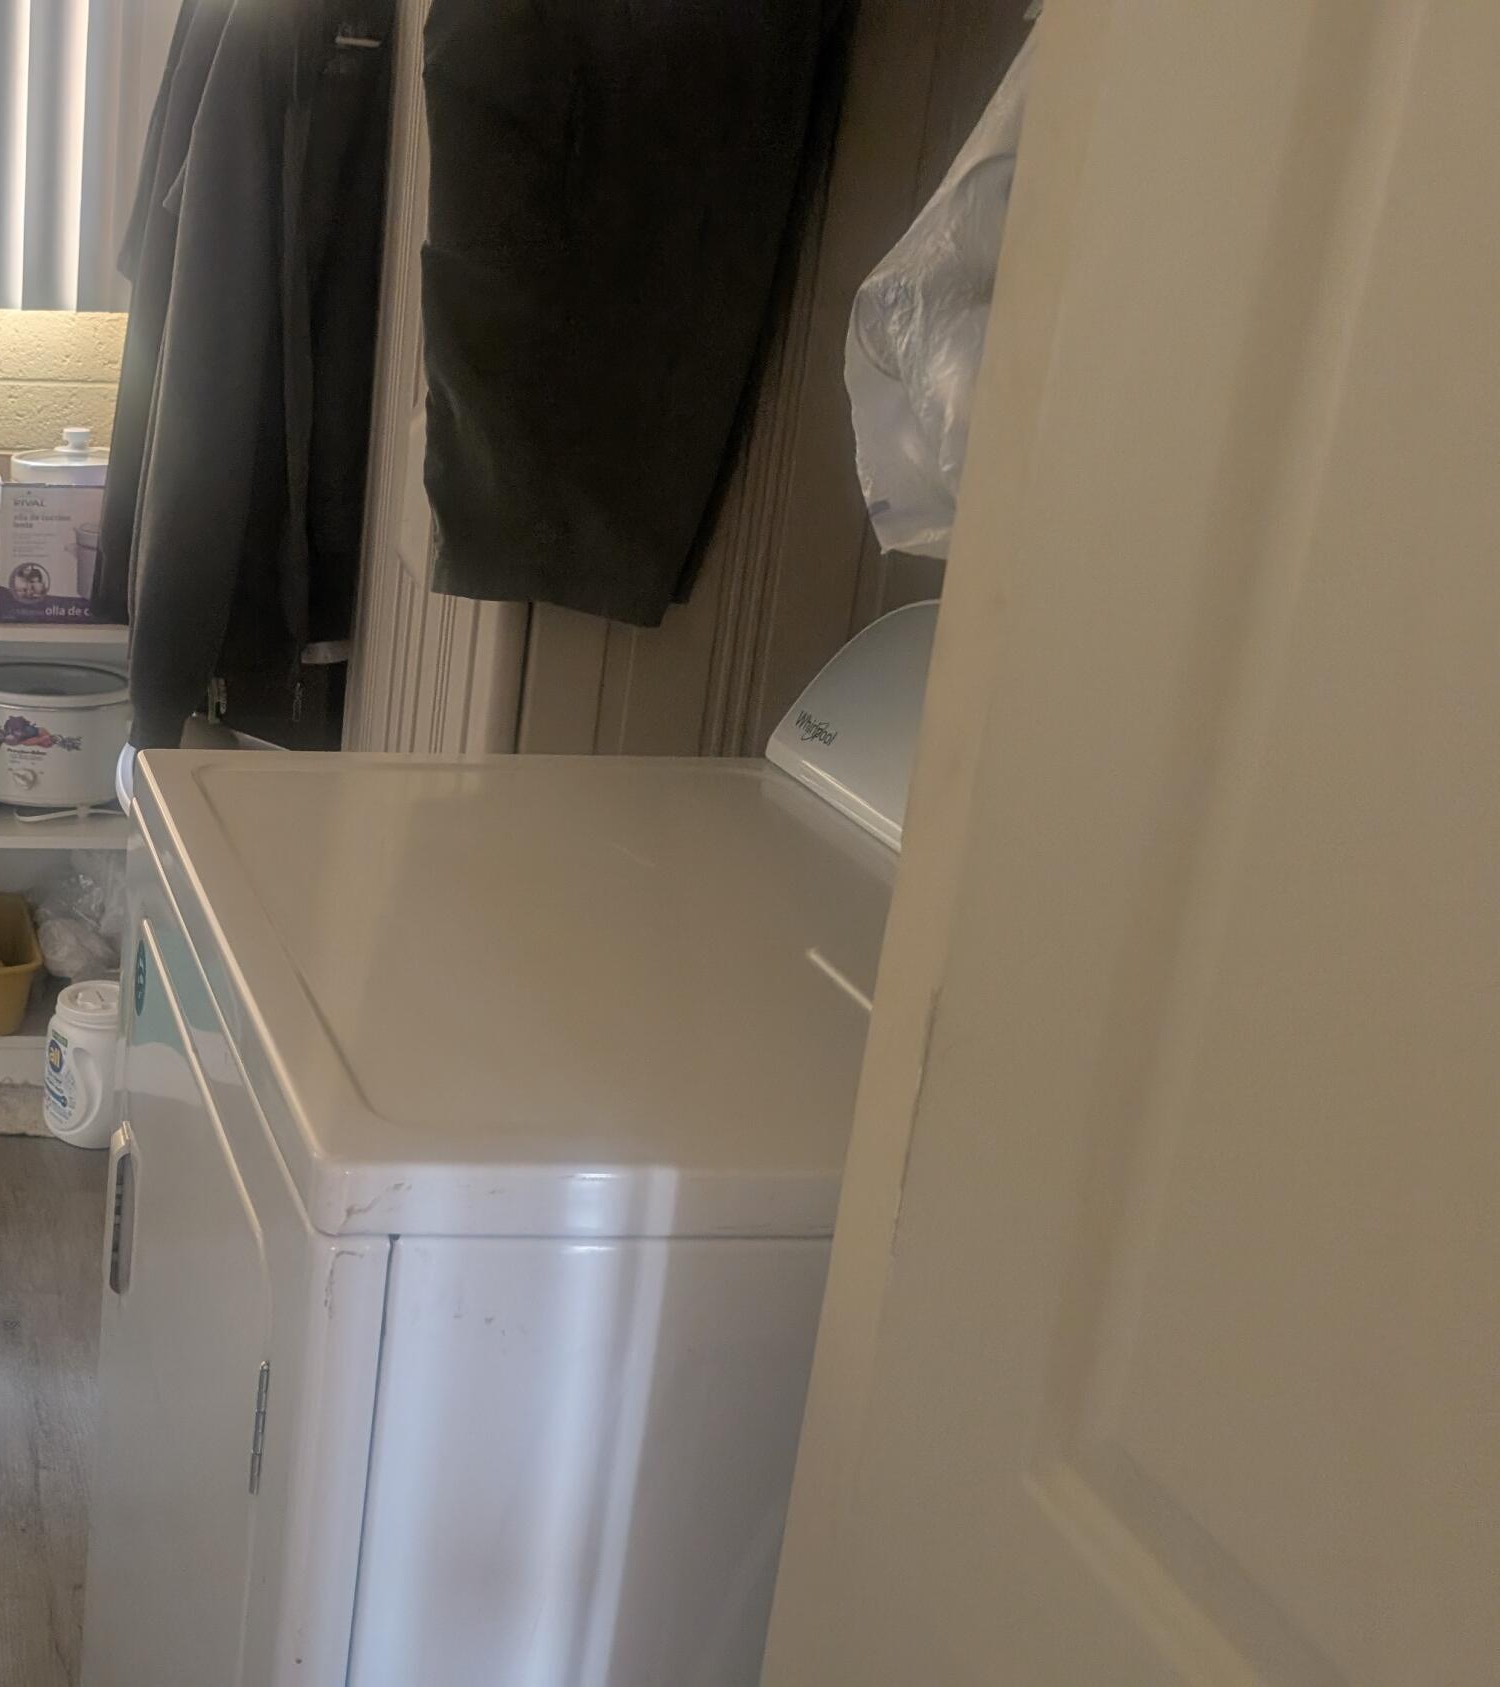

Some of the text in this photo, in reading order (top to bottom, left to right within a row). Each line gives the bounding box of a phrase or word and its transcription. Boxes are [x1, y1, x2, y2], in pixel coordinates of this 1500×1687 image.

[44, 603, 66, 617] olla
[67, 604, 82, 617] de
[795, 710, 838, 746] Whirlpool
